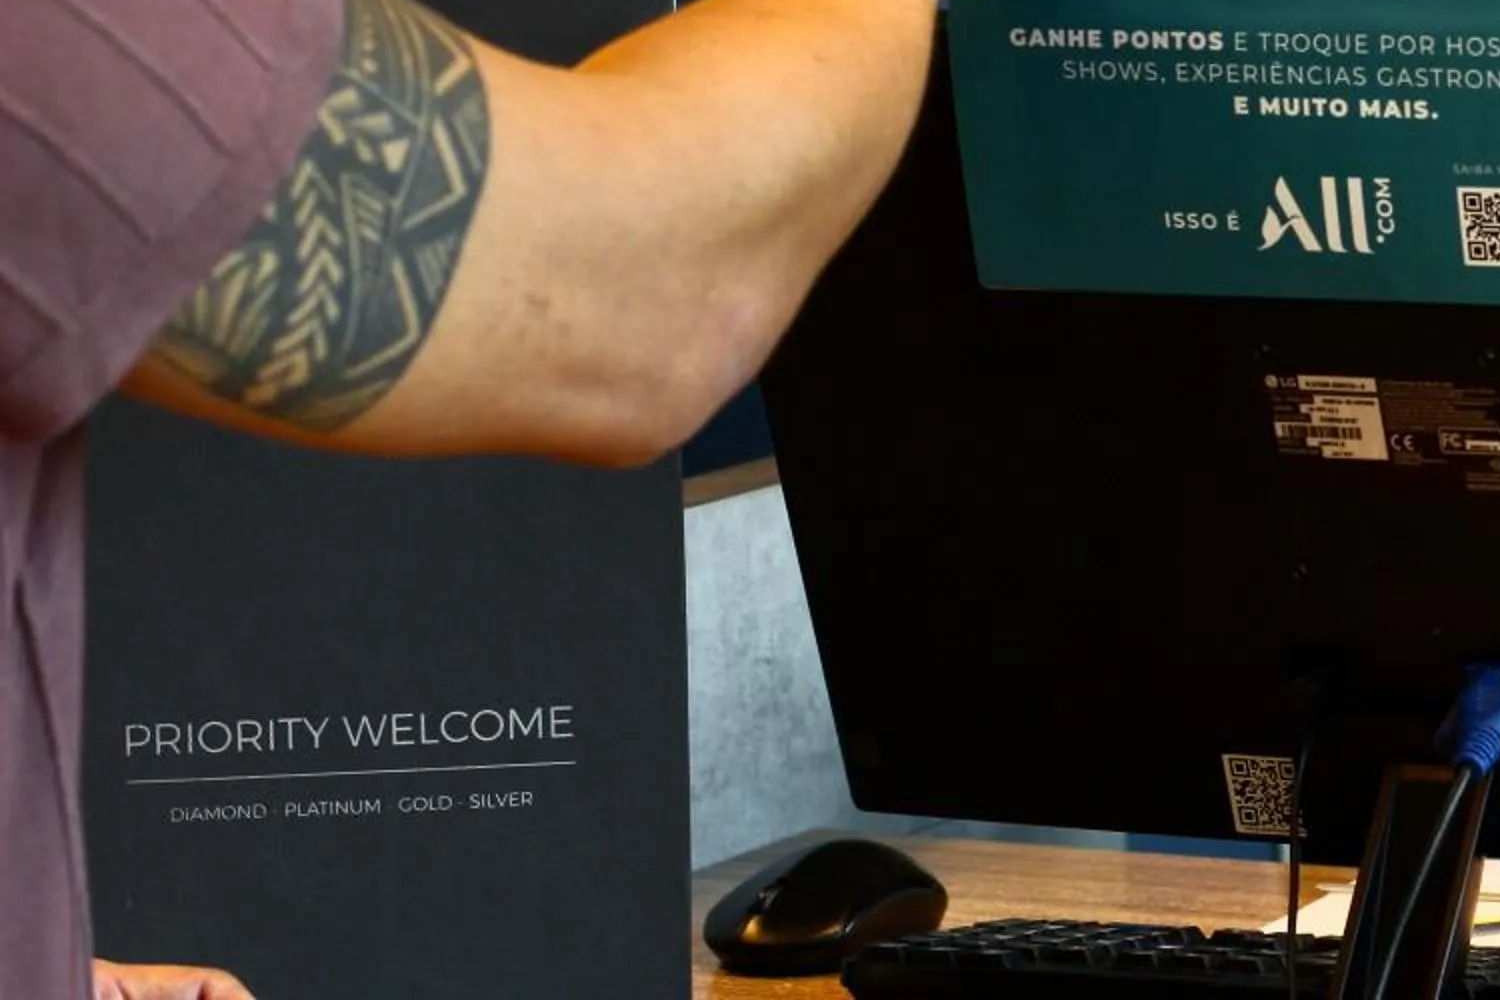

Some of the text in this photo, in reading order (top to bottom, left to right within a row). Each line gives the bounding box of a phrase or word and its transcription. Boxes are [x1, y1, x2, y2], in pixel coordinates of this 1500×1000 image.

[1009, 28, 1102, 48] GANHE
[1113, 30, 1224, 50] PONTOS
[1234, 32, 1249, 51] E
[1257, 32, 1369, 57] TROQUE
[1379, 34, 1435, 55] POR
[1062, 60, 1166, 85] SHOWS,
[1175, 62, 1367, 86] EXPERIÊNCIAS
[1233, 96, 1439, 121] E MUITO MAIS.
[1164, 212, 1218, 230] ISSO
[1227, 209, 1240, 231] É
[125, 705, 575, 757] PRIORITY WELCOME
[170, 791, 534, 823] DIAMOND PLATINUM GOLD SILVER
